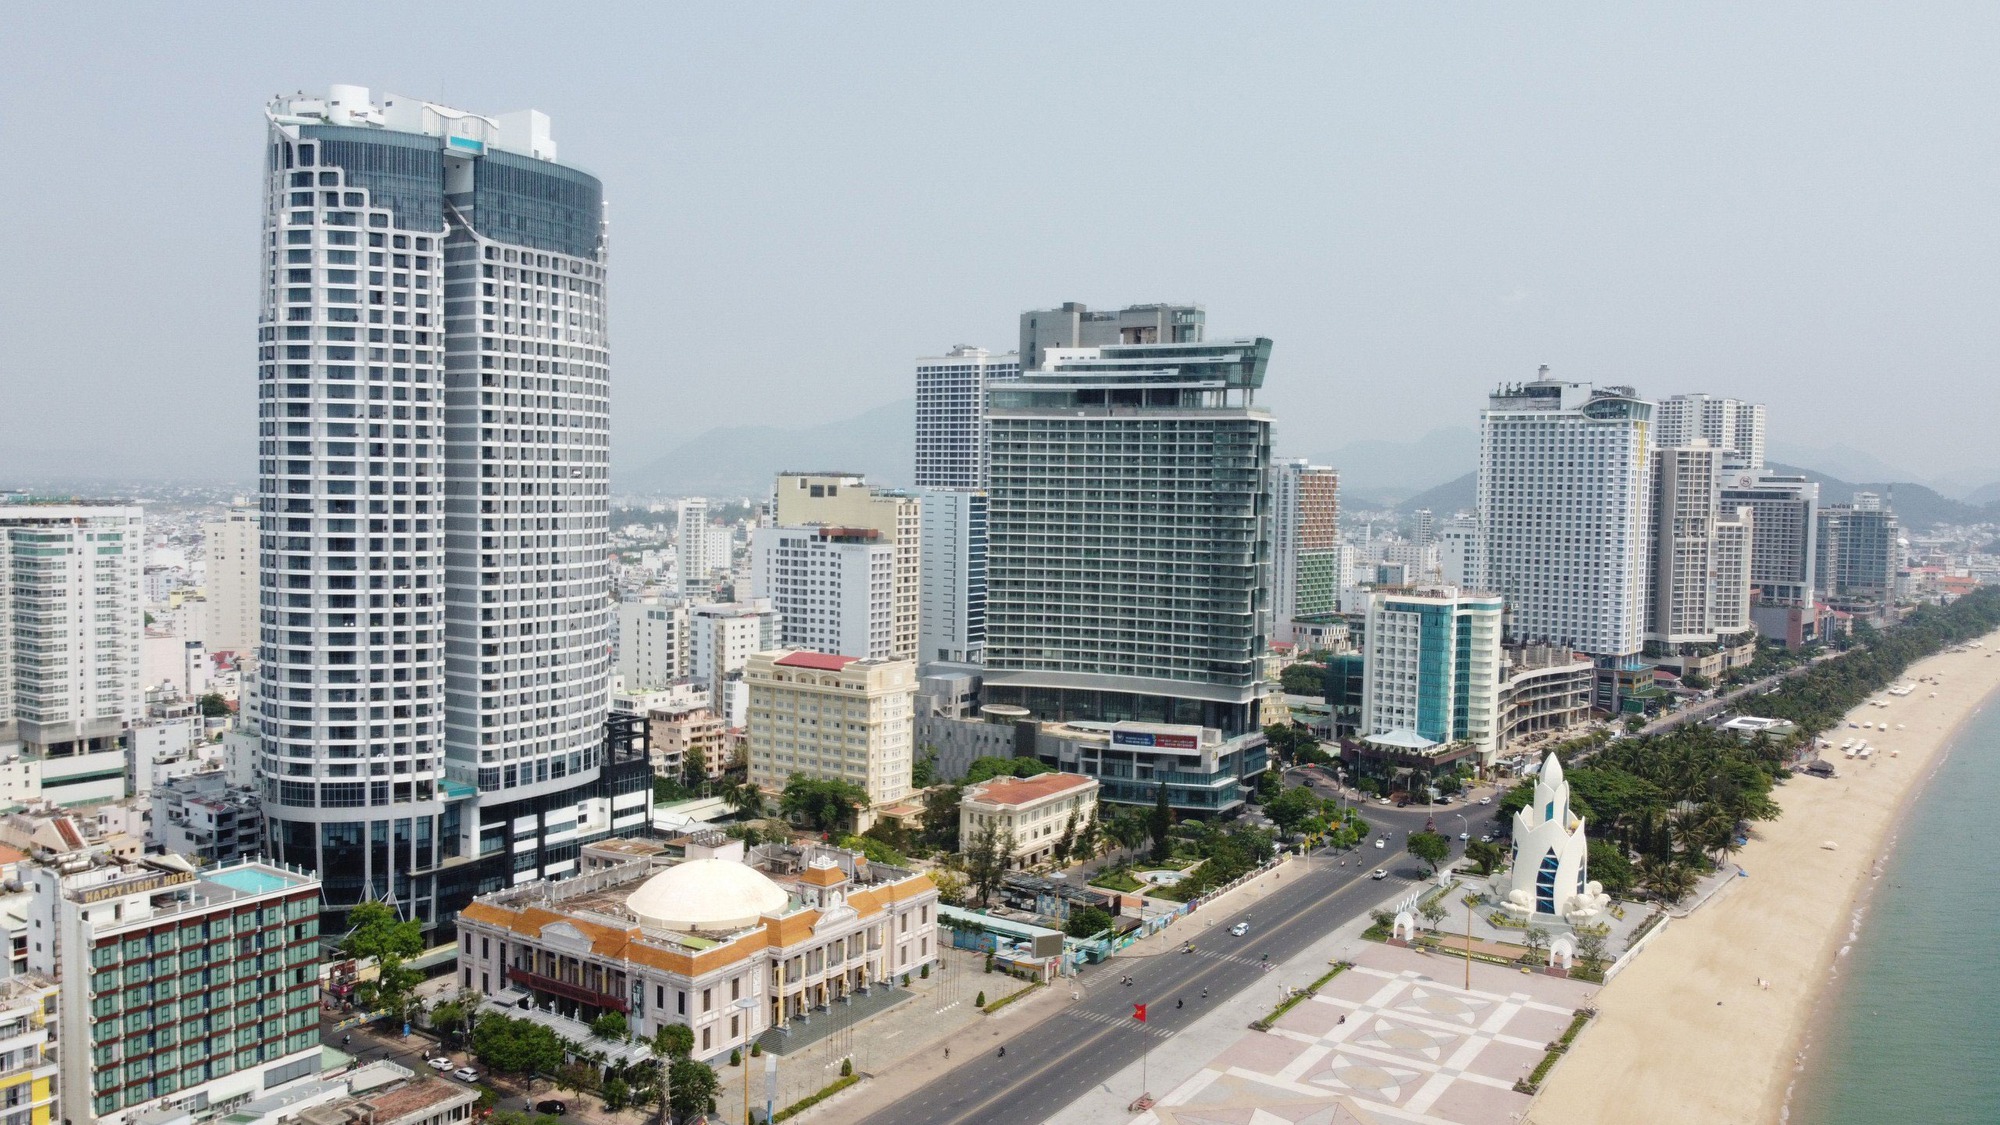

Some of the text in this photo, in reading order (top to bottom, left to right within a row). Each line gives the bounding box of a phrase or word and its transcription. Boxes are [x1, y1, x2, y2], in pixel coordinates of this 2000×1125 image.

[85, 871, 196, 902] HAPPY LIGHT HOTEL
